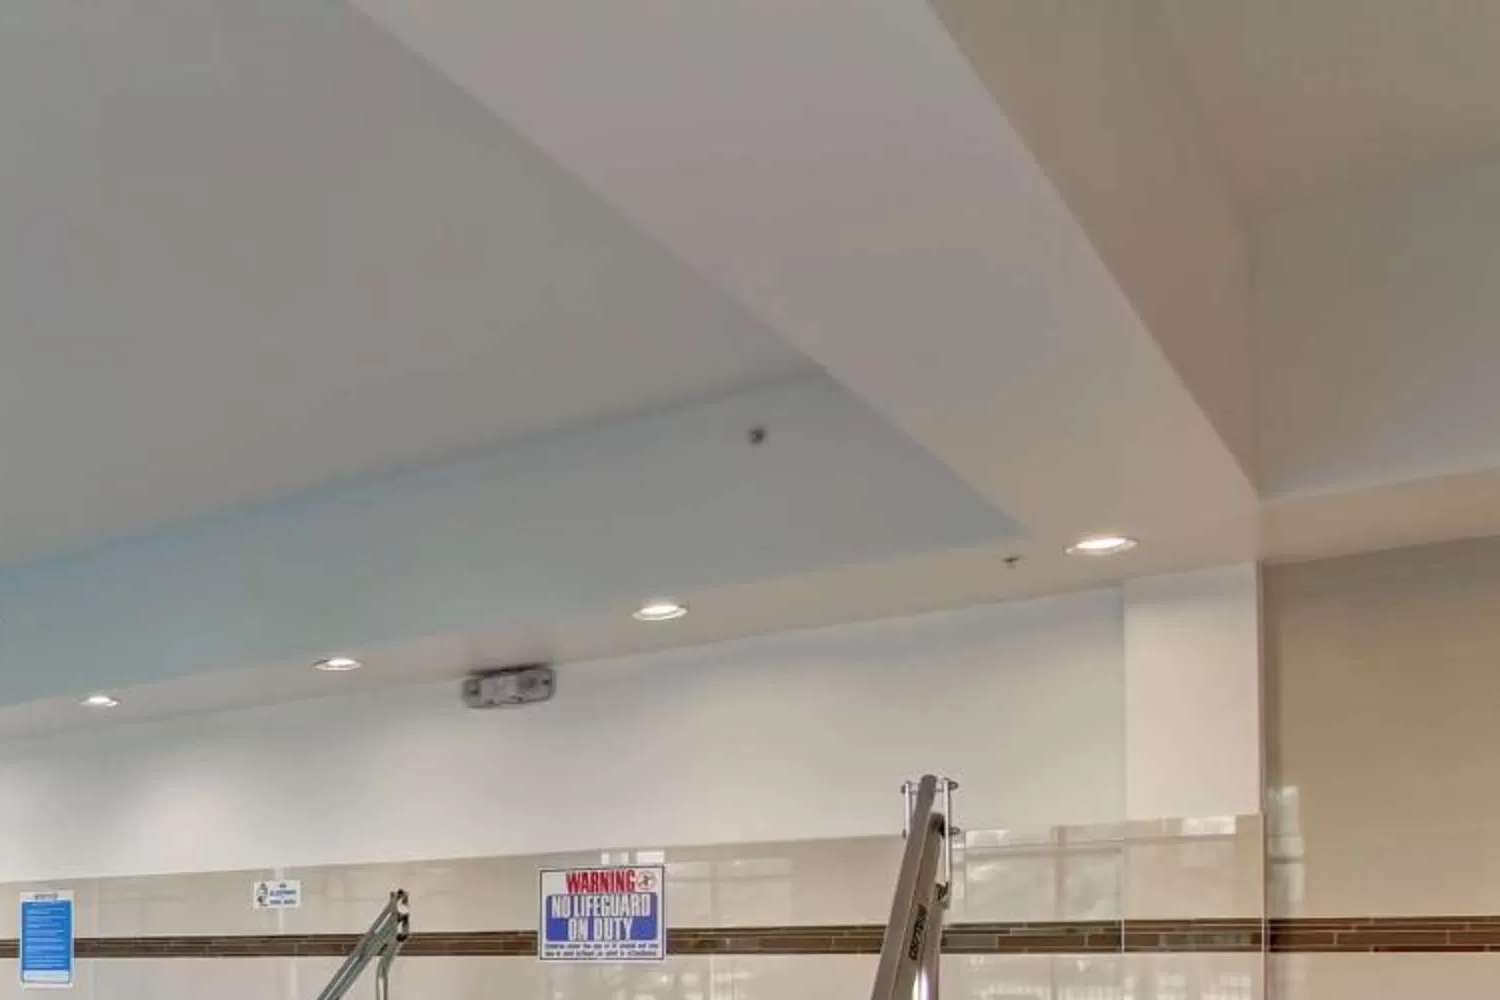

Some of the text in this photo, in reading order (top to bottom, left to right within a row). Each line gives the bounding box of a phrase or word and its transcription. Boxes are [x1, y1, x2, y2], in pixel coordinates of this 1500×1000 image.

[566, 870, 635, 893] WARNING
[551, 894, 650, 918] NO LIFEGUARD
[568, 917, 633, 941] ON DUTY
